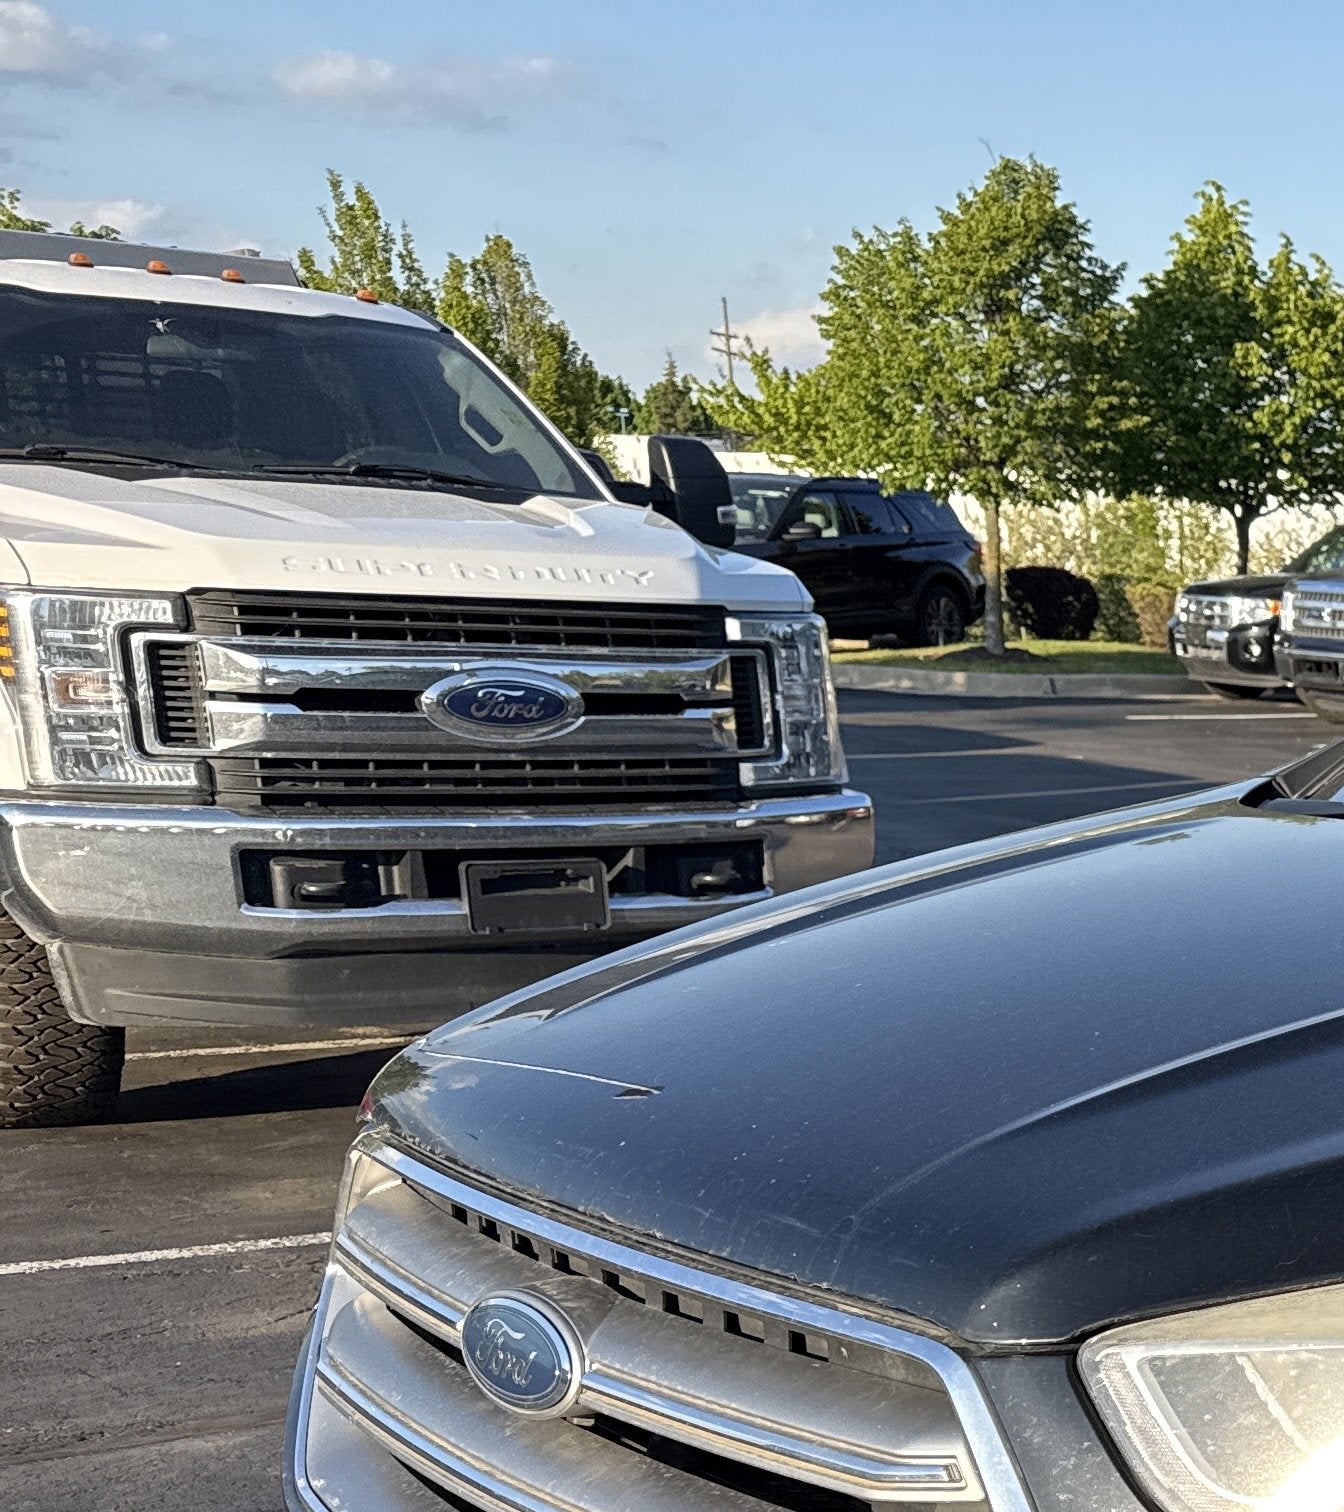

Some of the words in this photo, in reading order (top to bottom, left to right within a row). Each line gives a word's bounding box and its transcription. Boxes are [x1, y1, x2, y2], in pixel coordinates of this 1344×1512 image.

[282, 556, 501, 581] SUPER
[507, 564, 655, 586] DUTY
[470, 687, 546, 720] Ford
[475, 1317, 538, 1388] Ford
